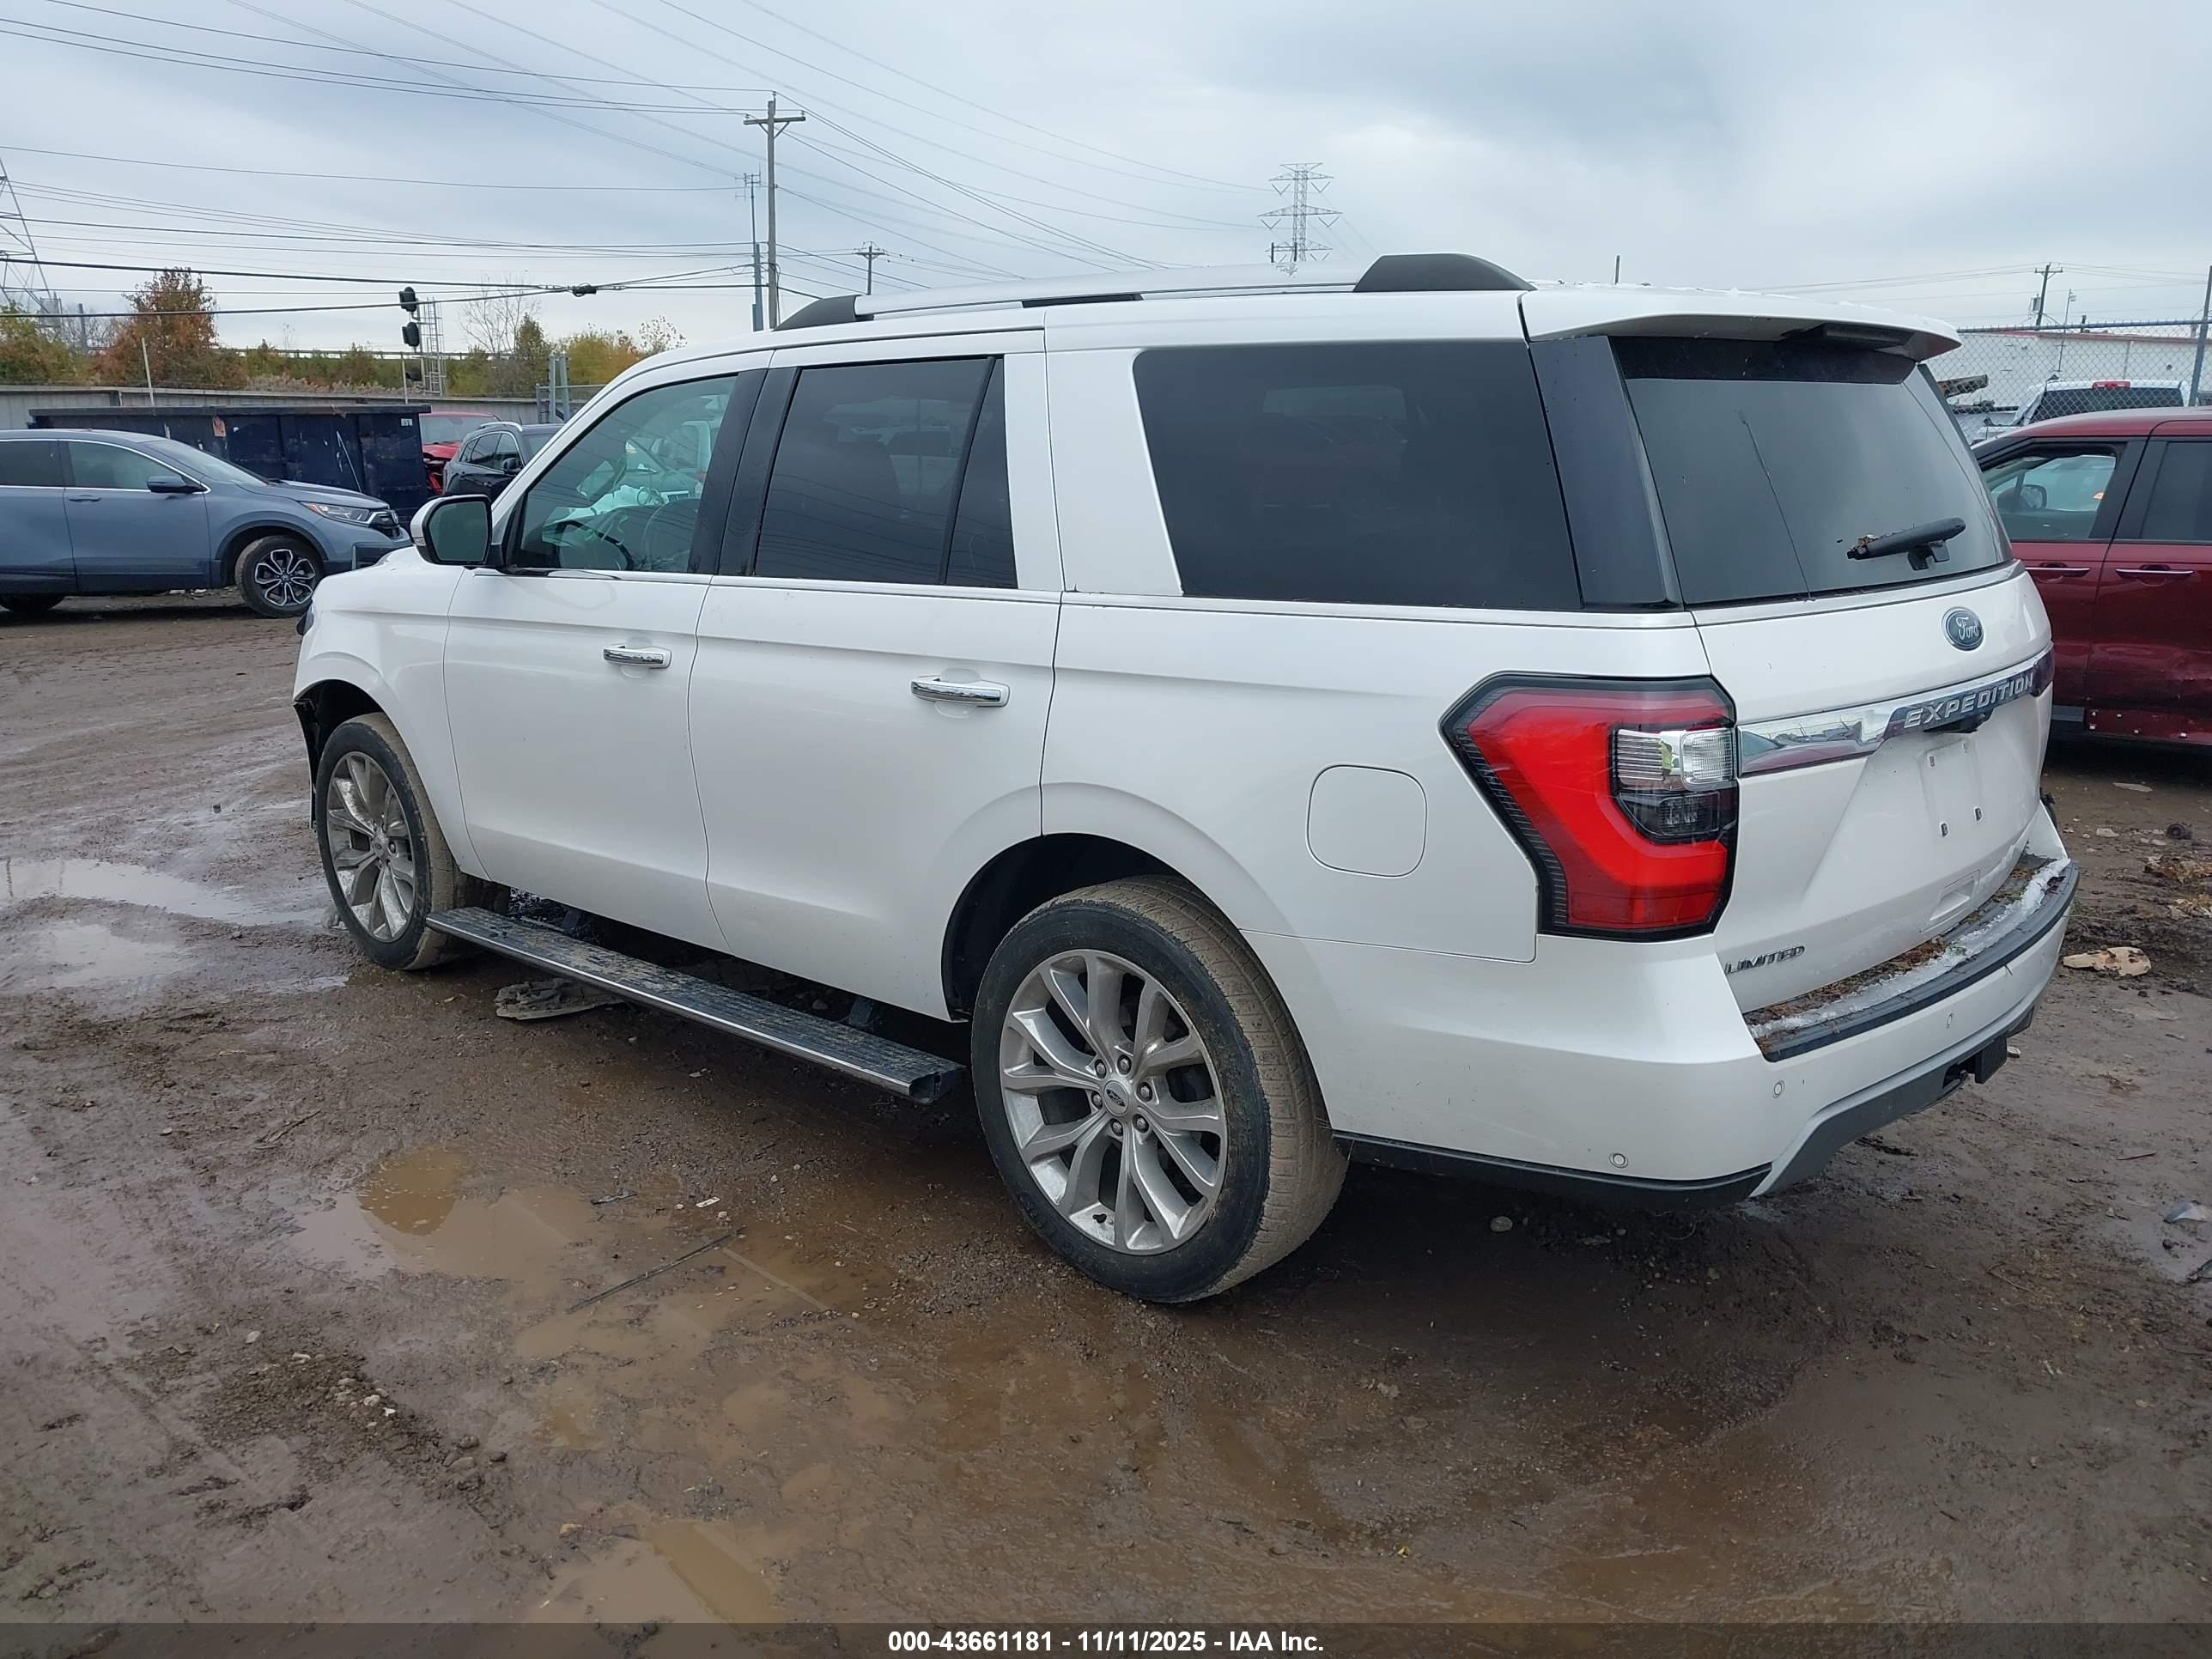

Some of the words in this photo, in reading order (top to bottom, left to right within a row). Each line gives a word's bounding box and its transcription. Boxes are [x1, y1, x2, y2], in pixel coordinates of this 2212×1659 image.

[1955, 616, 1980, 641] Ford
[1903, 672, 2034, 729] EXPEDITION
[1724, 945, 1806, 975] LIMITED
